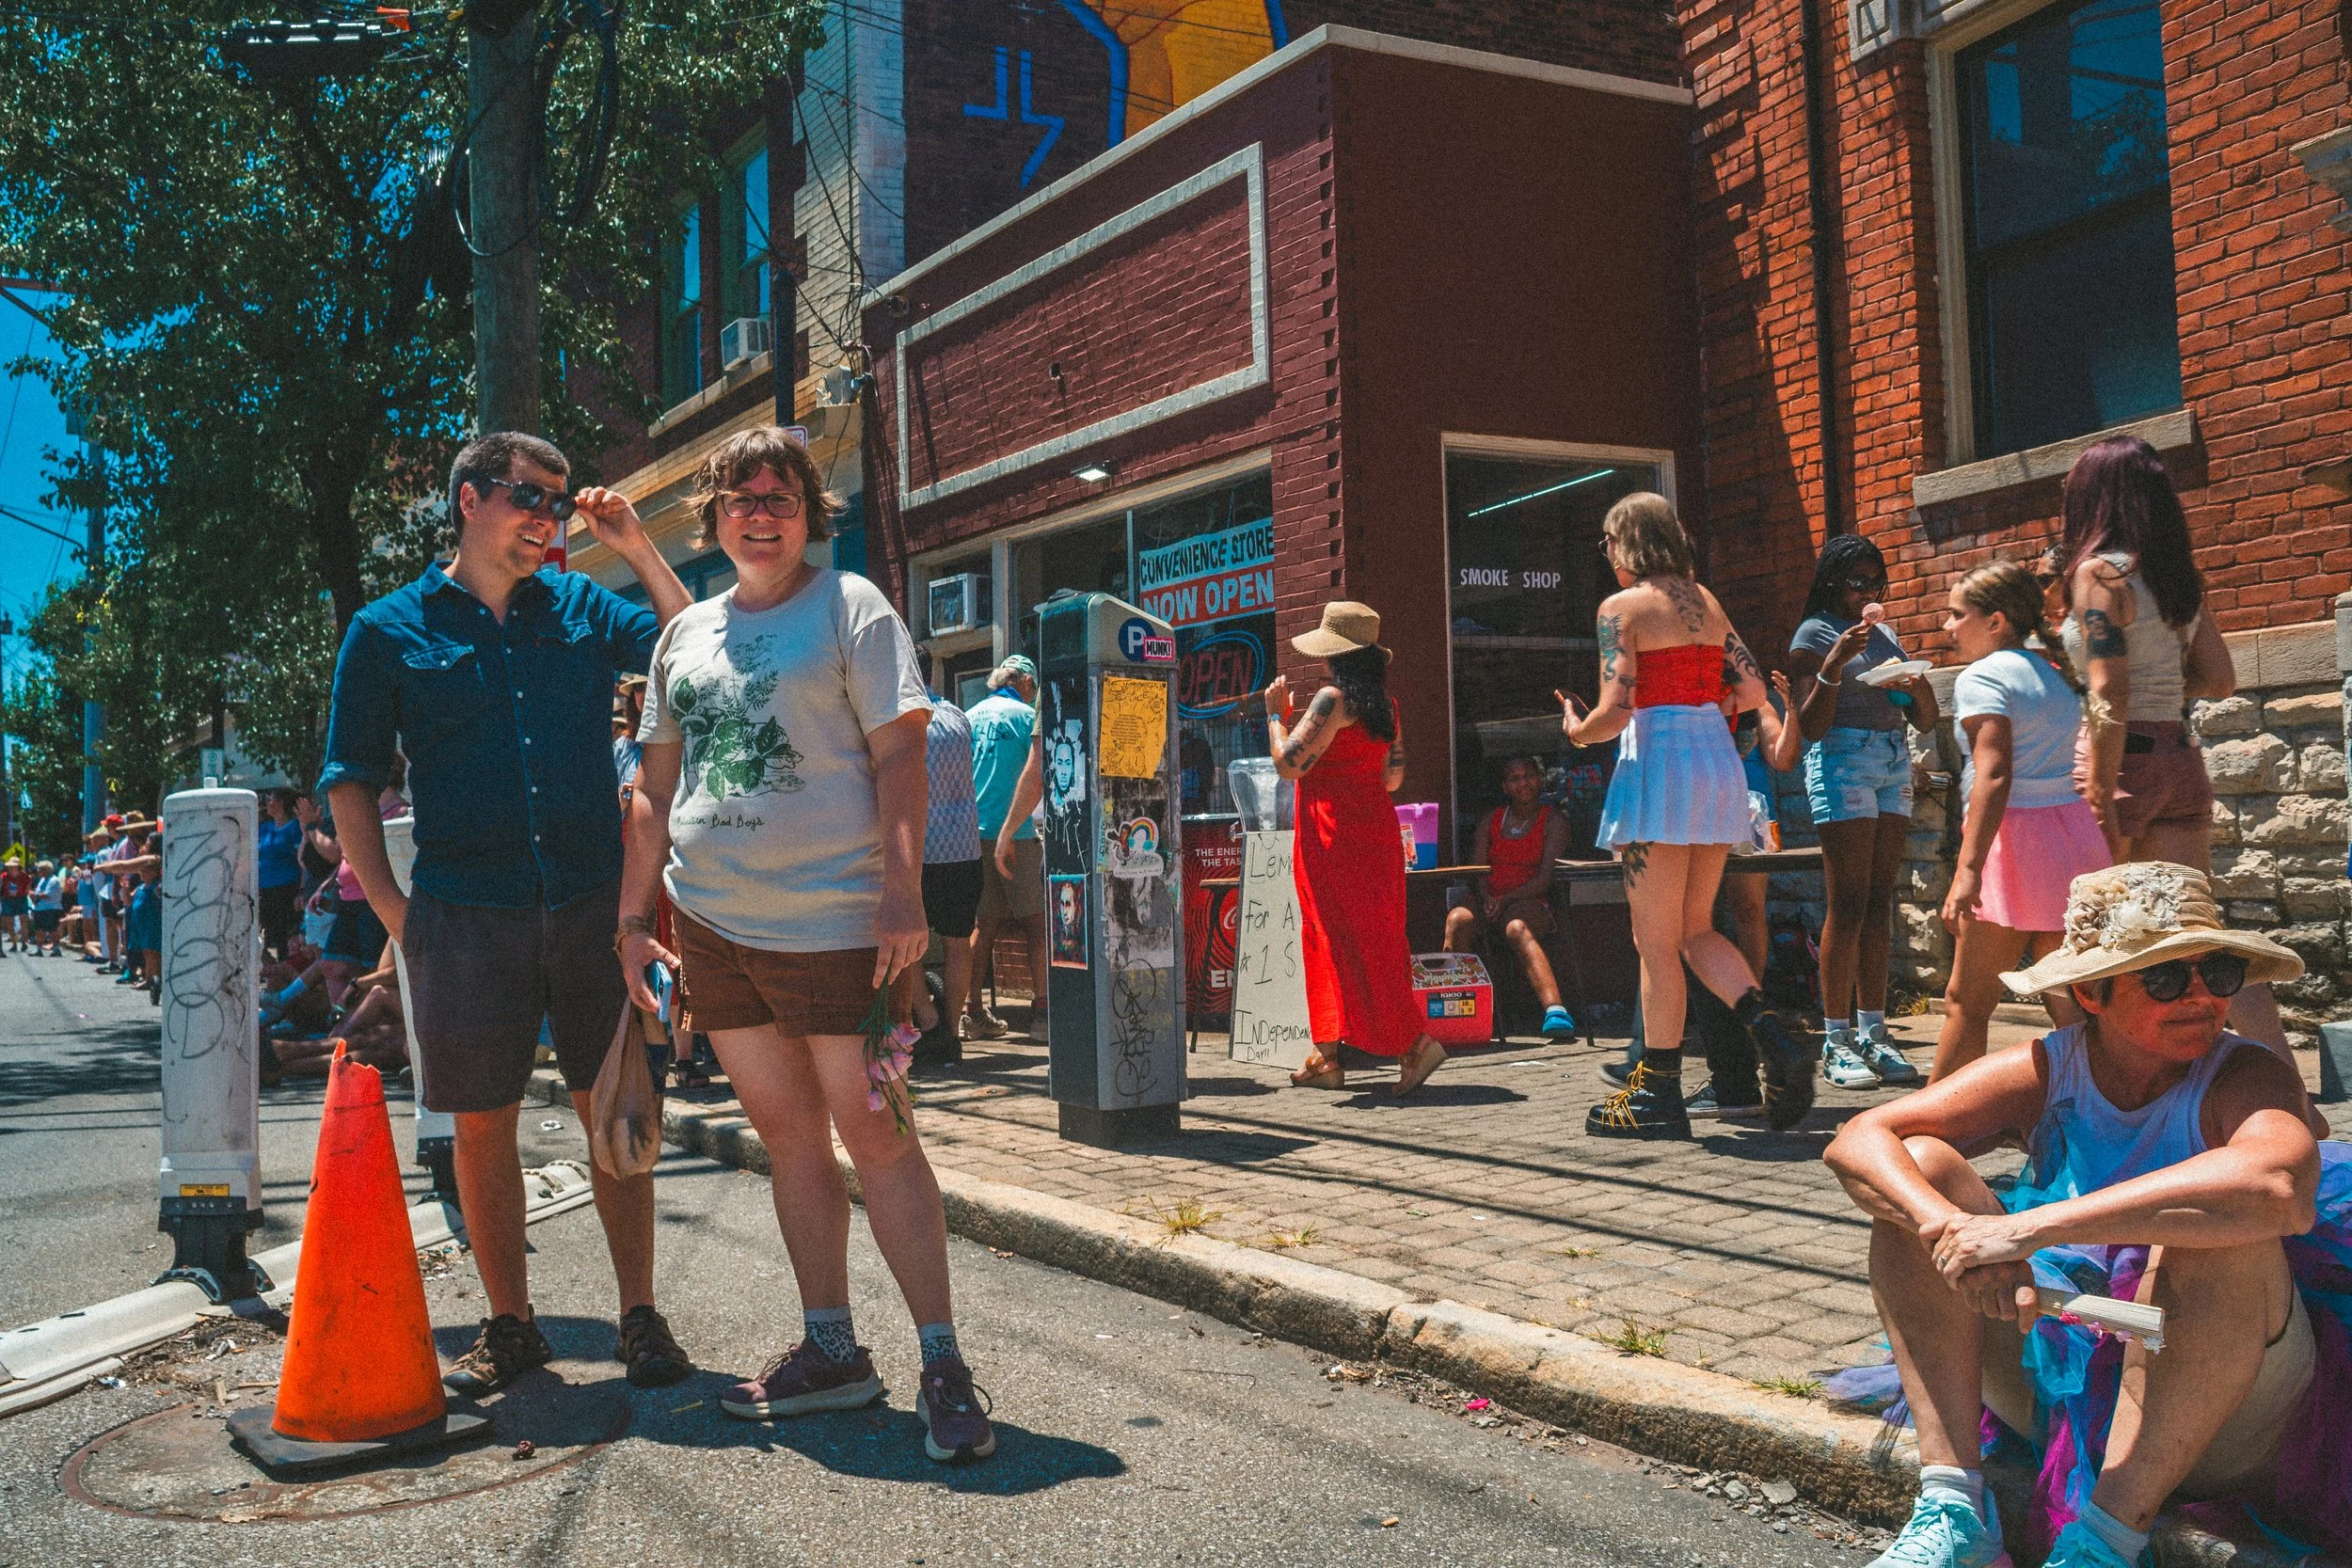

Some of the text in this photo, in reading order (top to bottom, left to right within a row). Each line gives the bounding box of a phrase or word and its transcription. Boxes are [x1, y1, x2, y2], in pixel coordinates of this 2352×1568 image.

[1139, 526, 1275, 587] CONVENIENCE STORE
[1460, 568, 1562, 589] SMOKE SHOP
[1143, 569, 1275, 624] NOW OPEN
[1127, 626, 1146, 655] P
[1146, 640, 1171, 657] MUNK!
[1177, 649, 1252, 704] OPEN
[710, 814, 732, 829] Bad
[737, 815, 765, 832] Boys
[1195, 847, 1242, 857] THE ENER
[1201, 858, 1242, 867] THE TAS
[1281, 900, 1295, 931] A
